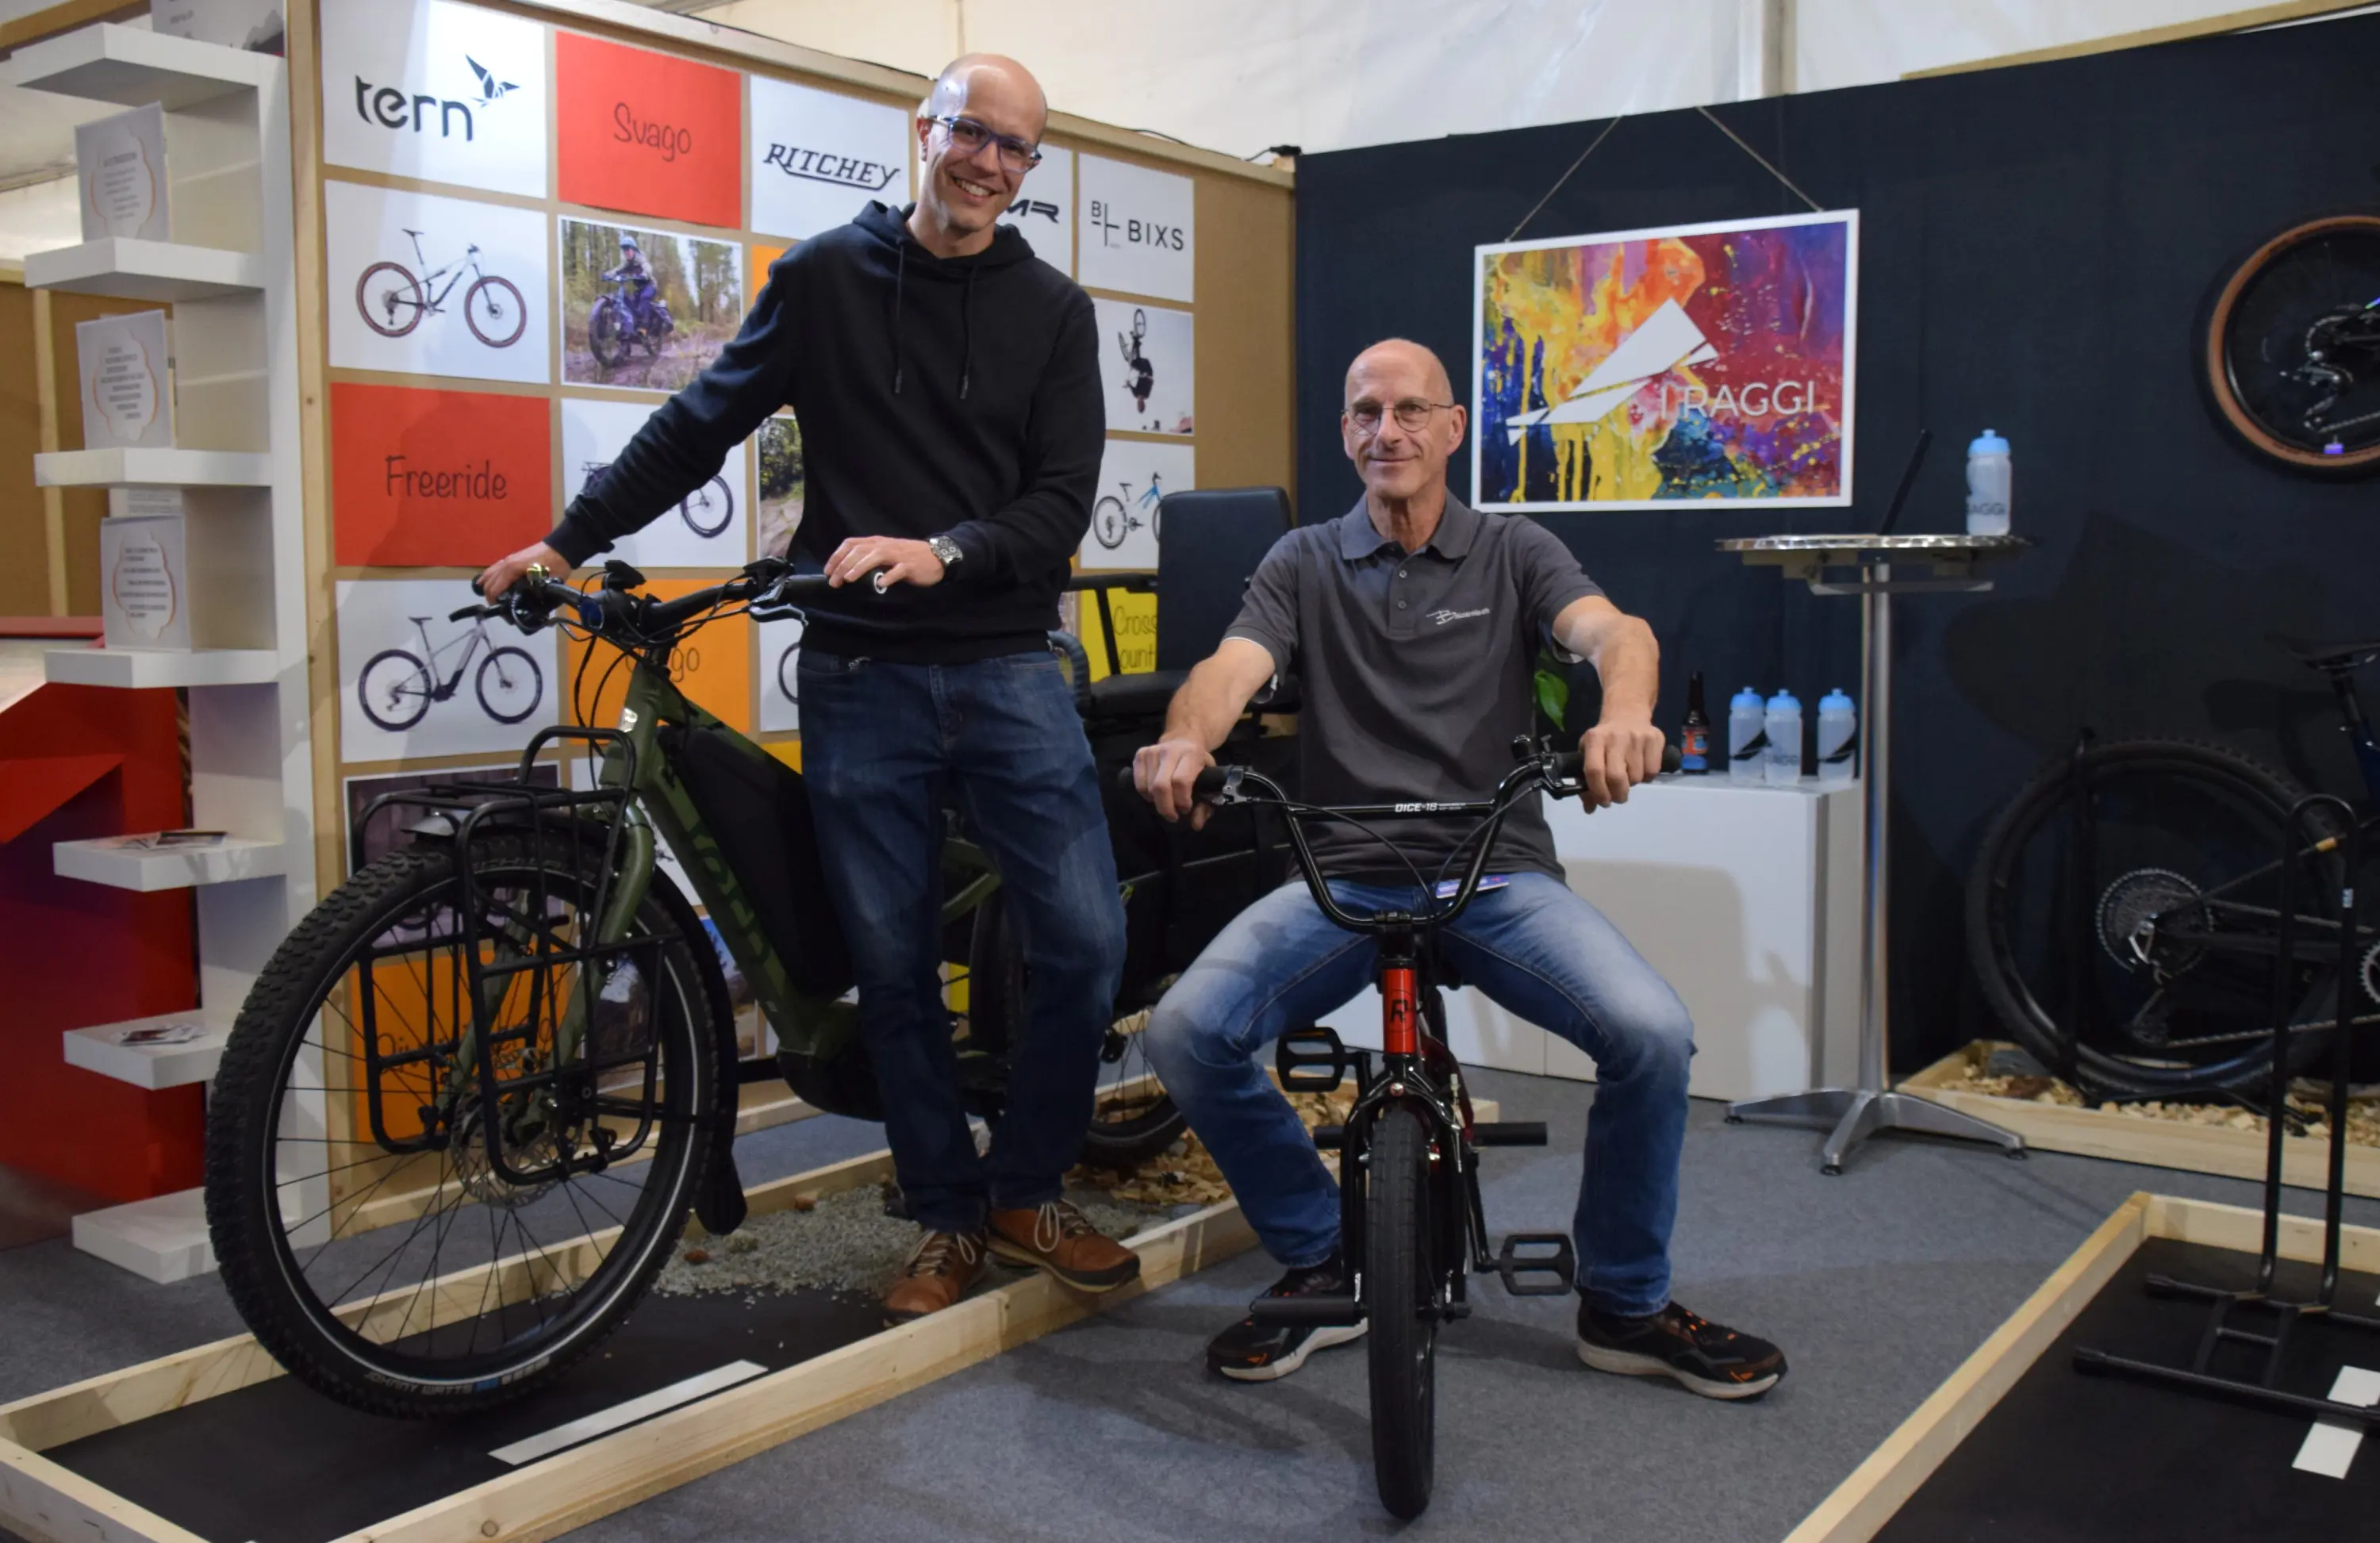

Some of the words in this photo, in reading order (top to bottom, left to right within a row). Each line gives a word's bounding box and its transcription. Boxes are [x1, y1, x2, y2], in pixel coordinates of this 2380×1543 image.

[355, 75, 474, 142] tern
[613, 102, 692, 163] Svago
[762, 143, 901, 191] RITCHEY
[1007, 199, 1059, 224] MR
[1127, 219, 1184, 251] BIXS
[1684, 380, 1815, 420] RAGGI
[385, 455, 507, 500] Freeride
[1113, 605, 1157, 636] Cross
